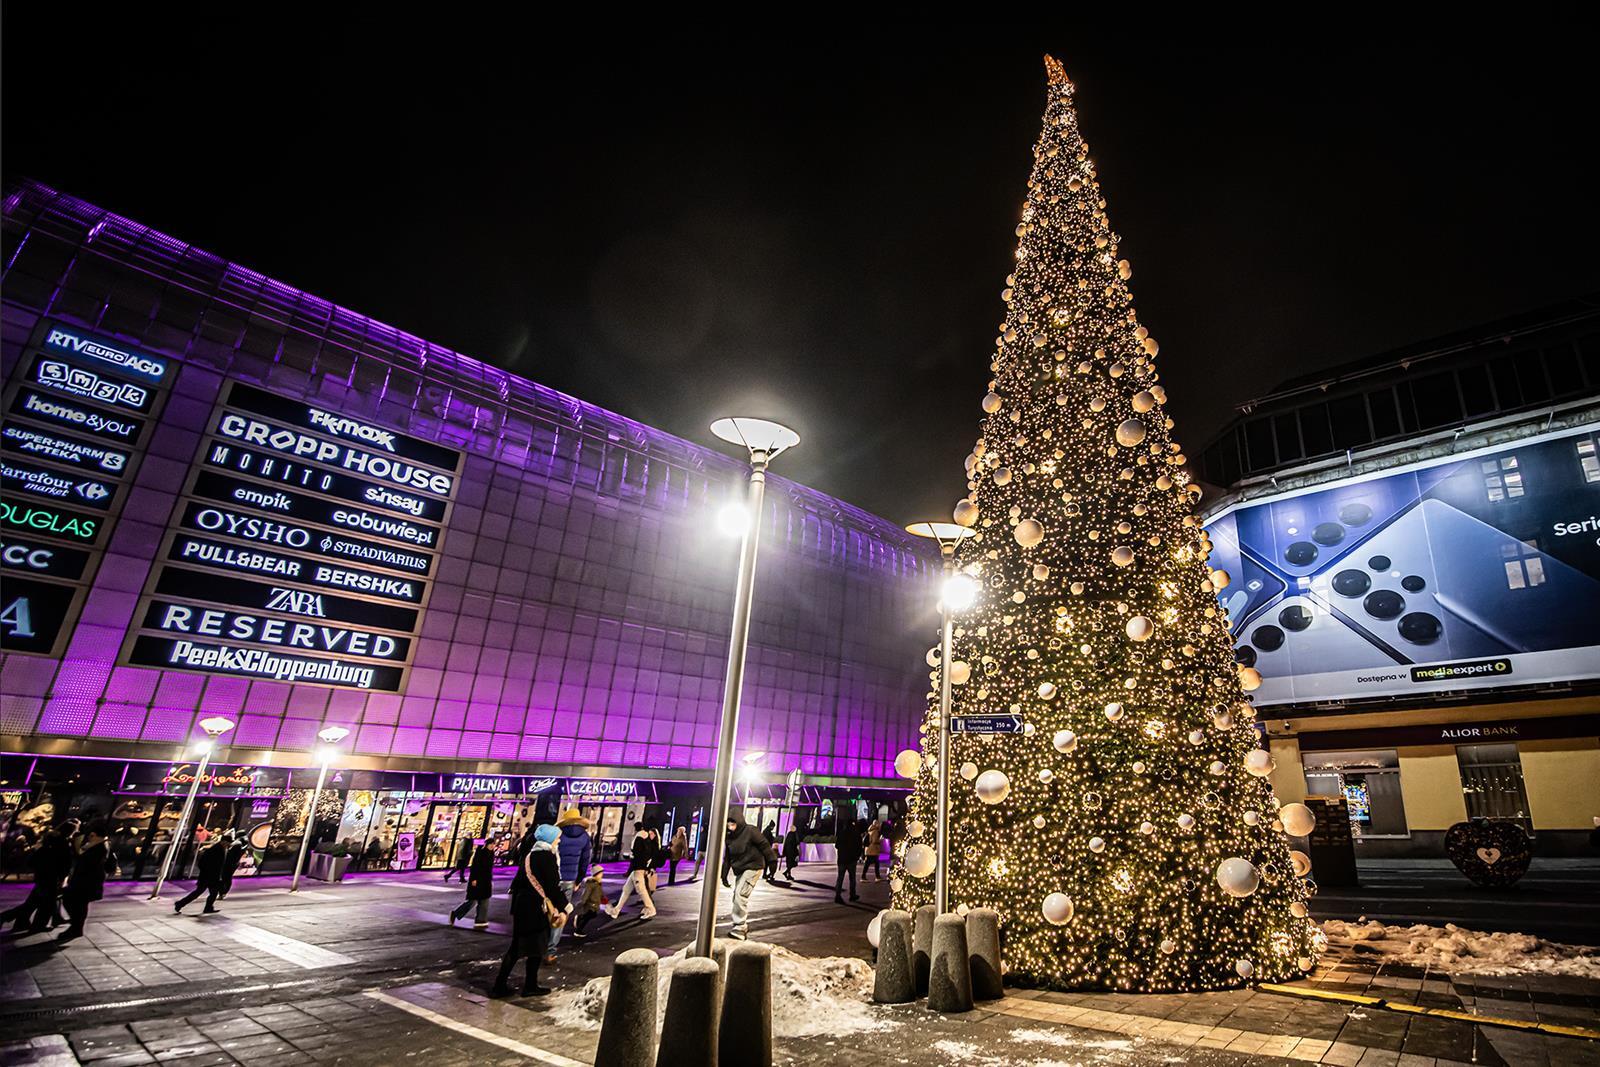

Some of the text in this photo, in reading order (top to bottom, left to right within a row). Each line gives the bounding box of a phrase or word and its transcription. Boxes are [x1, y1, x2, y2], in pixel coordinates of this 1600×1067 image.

[48, 330, 164, 376] RTV EURO AGD
[4, 428, 104, 459] SUPER-PHARM
[22, 442, 80, 462] APTEKA
[220, 415, 338, 460] CROPP
[0, 462, 72, 489] arrefour
[24, 482, 69, 497] market
[211, 446, 425, 515] MOHITO sinsay
[234, 486, 433, 544] empik eobuwie.pl
[196, 509, 427, 570] OYSHO STRADIVARIUS
[0, 544, 53, 568] CC
[183, 542, 413, 598] PULL&BEAR BERSHKA
[264, 587, 326, 618] ZARA
[161, 604, 395, 657] RESERVED
[169, 640, 374, 688] Peek&Cloppenburg
[1357, 675, 1397, 684] Dostępna
[1416, 663, 1494, 678] mediaexpert
[1441, 726, 1519, 738] ALIOR BANK
[452, 778, 510, 792] PIJALNIA
[570, 782, 637, 794] CZEKOLADY
